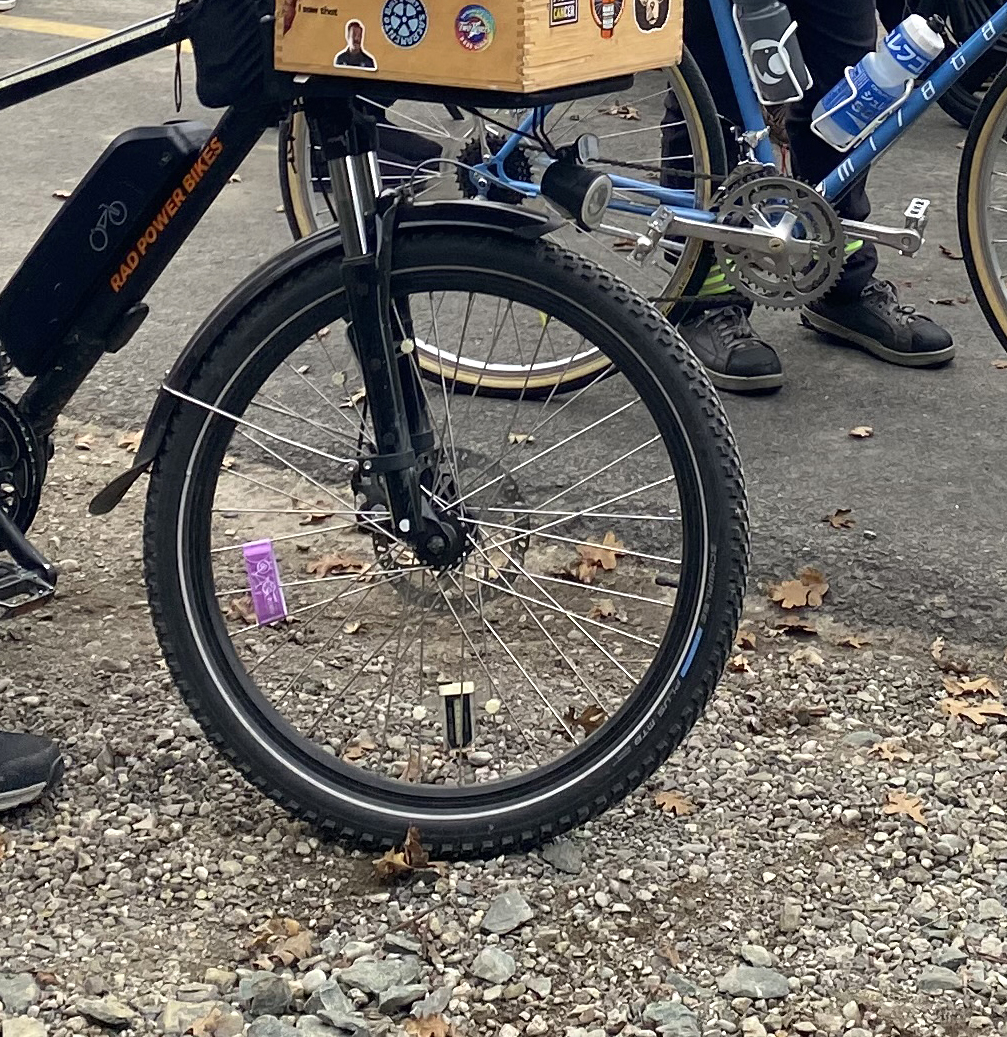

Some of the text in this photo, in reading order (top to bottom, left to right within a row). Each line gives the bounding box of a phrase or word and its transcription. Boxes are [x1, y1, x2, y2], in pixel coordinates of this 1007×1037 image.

[109, 136, 225, 294] RAD POWER BIKES
